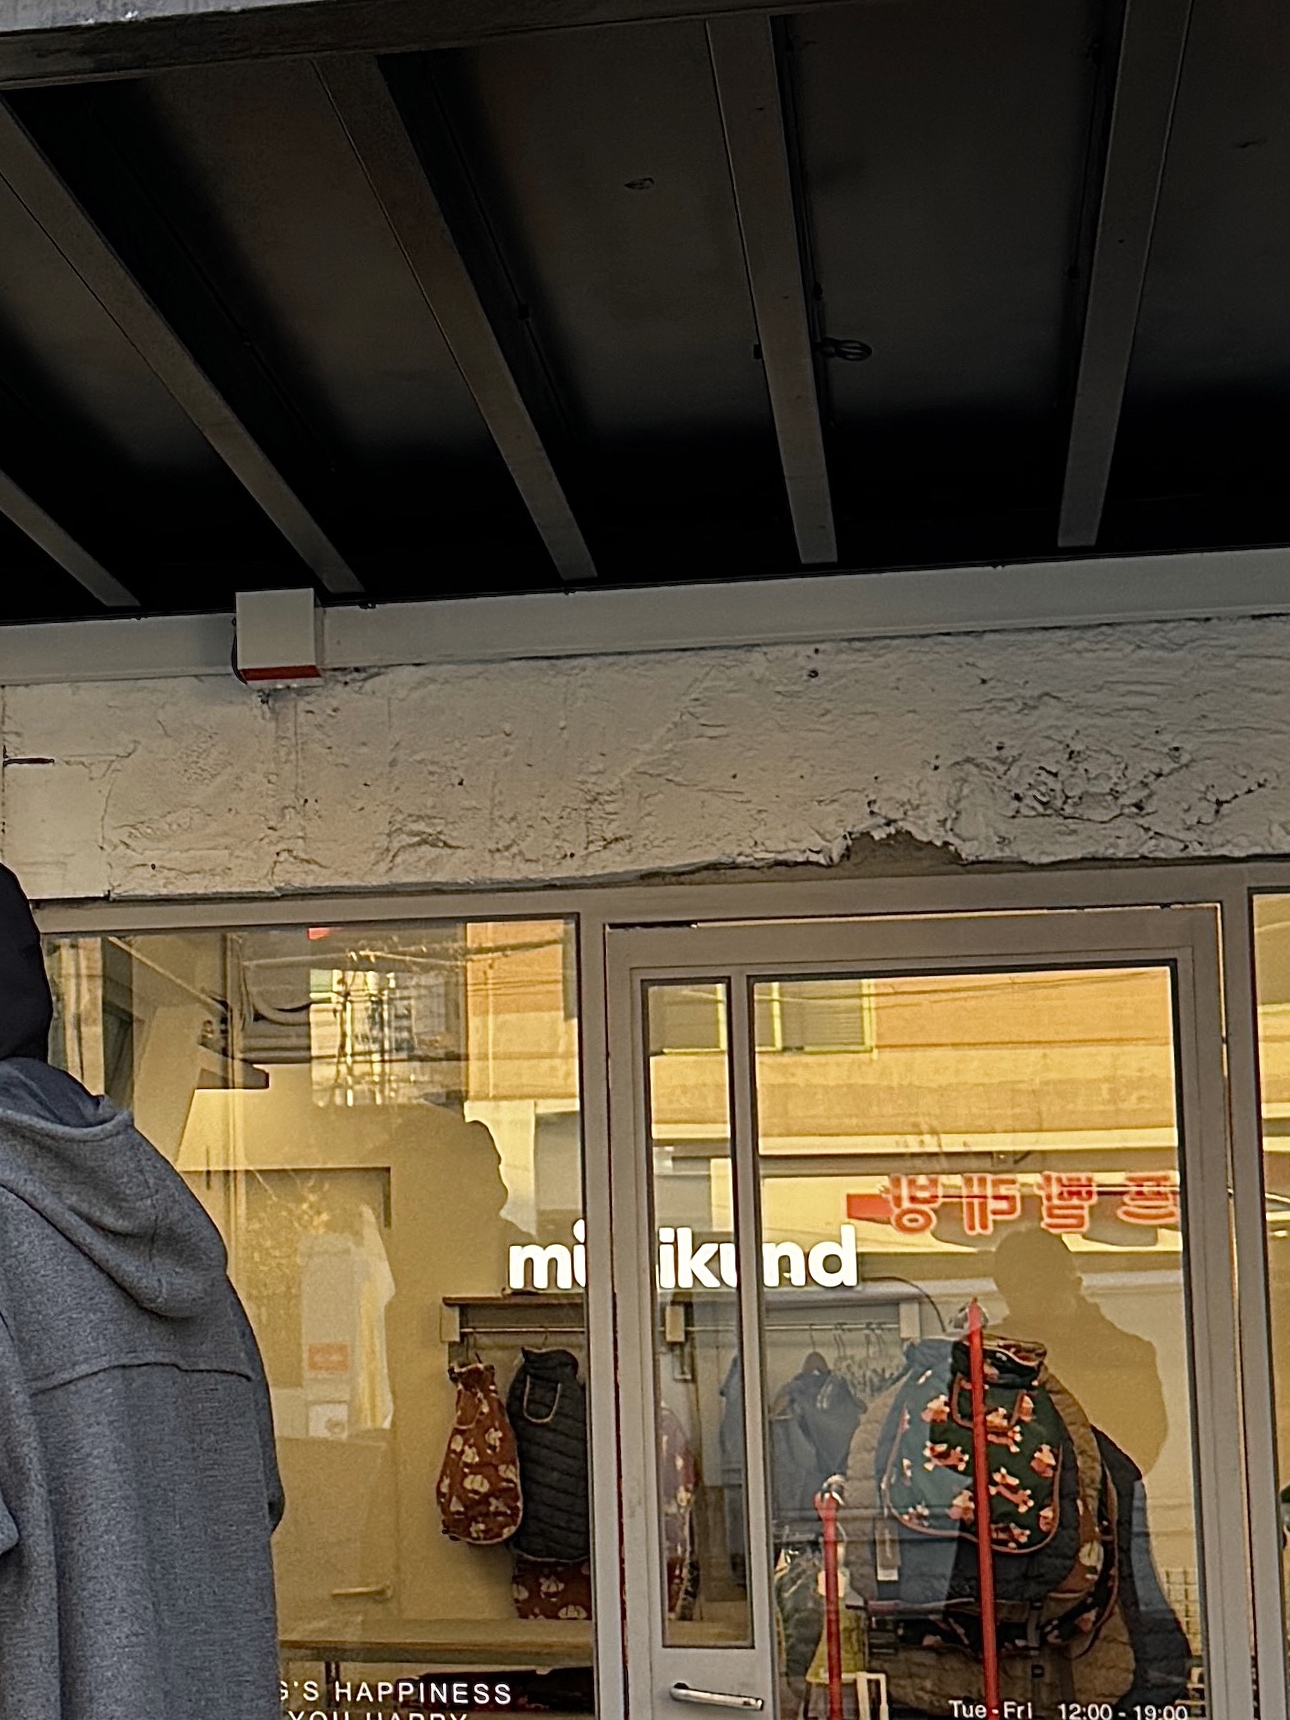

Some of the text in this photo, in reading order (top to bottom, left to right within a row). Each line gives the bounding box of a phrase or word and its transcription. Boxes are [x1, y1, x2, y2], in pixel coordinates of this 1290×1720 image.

[335, 1681, 511, 1705] HAPPINESS
[948, 1699, 987, 1719] Tue
[1003, 1701, 1033, 1720] Fri
